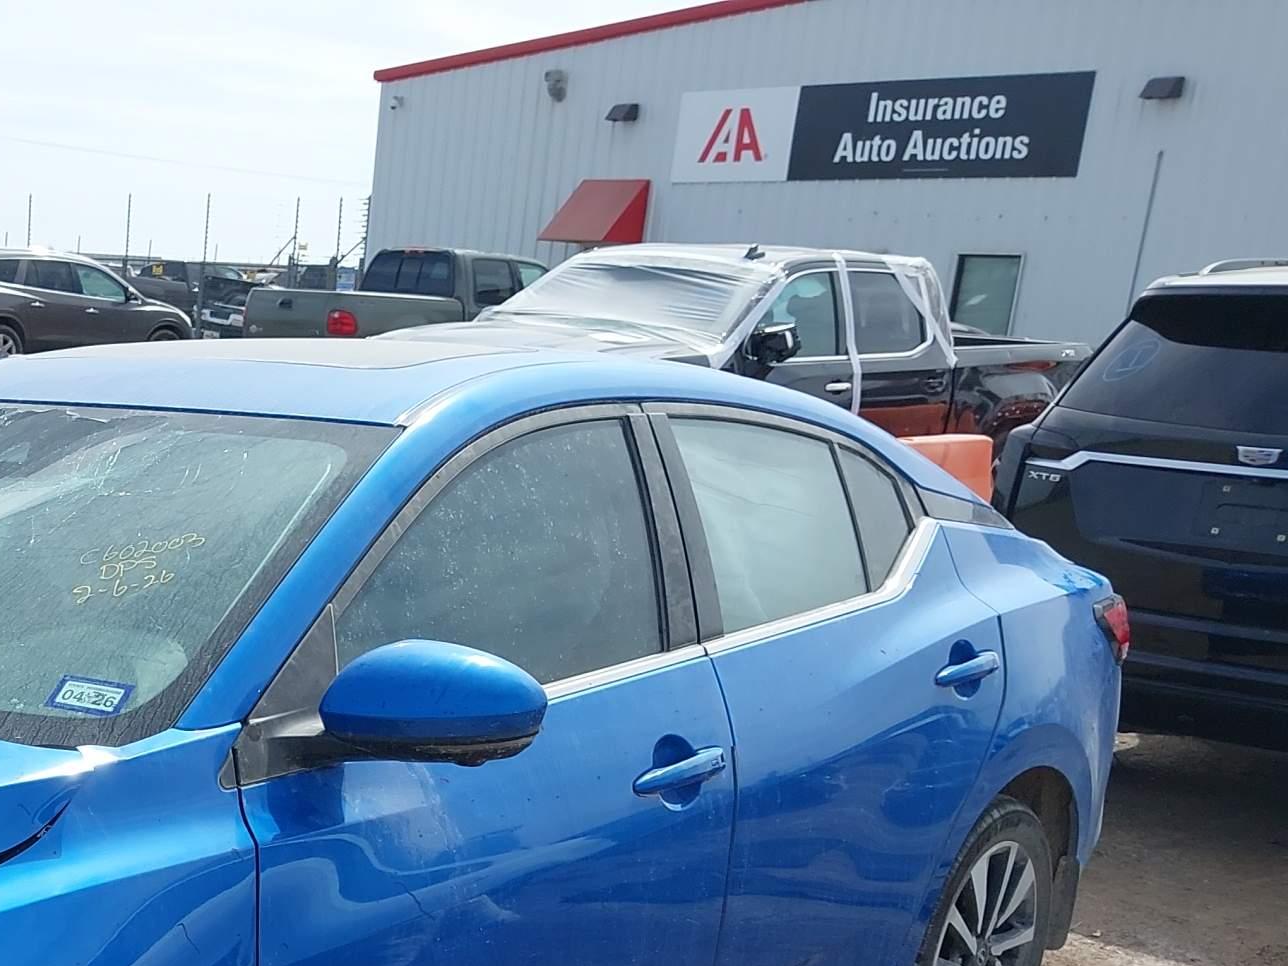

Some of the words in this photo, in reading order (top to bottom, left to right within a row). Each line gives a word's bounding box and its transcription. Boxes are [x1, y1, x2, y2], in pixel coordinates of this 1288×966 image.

[867, 92, 1007, 123] Insurance
[833, 132, 897, 163] Auto
[902, 128, 1030, 161] Auctions
[1028, 470, 1061, 482] XT6
[99, 555, 157, 580] DPS
[72, 569, 176, 605] 2-6-26
